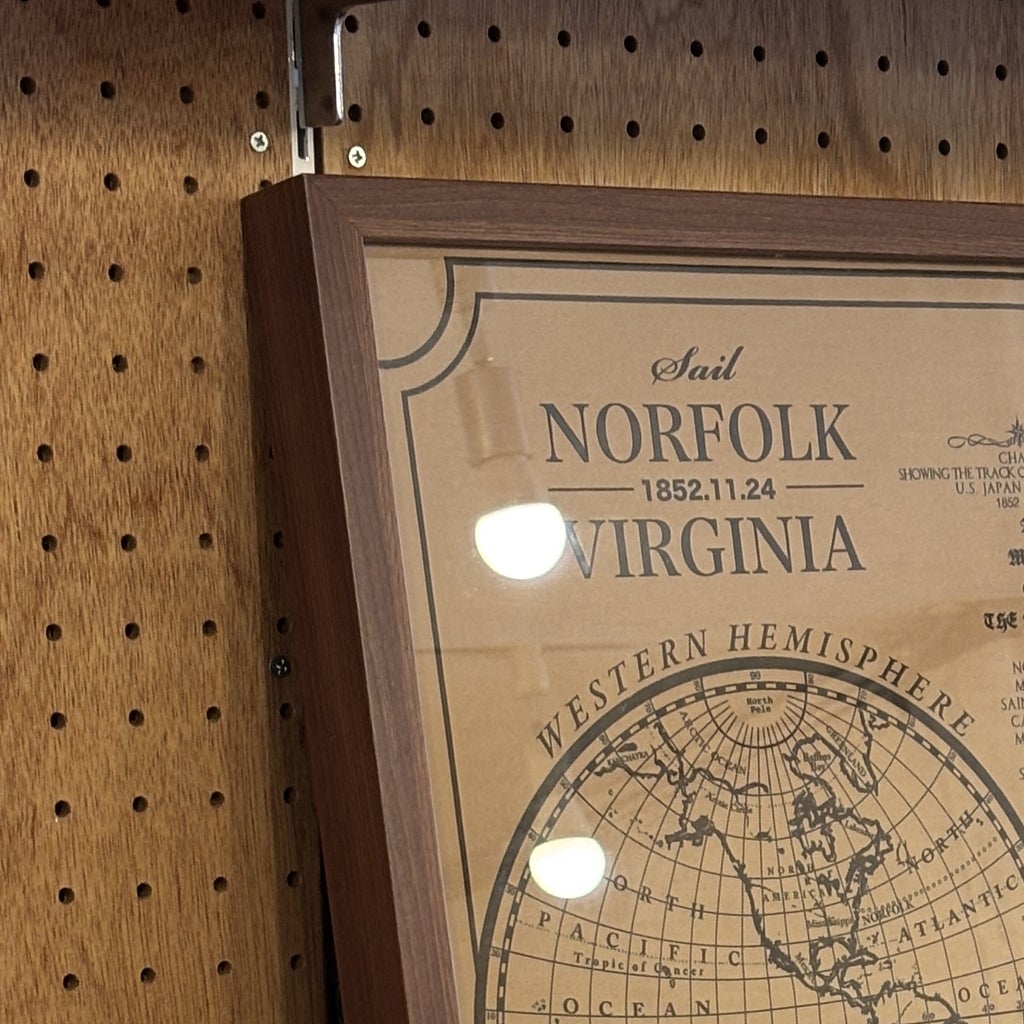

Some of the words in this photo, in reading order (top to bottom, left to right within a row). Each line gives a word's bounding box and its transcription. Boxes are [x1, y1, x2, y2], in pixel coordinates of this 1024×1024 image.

[651, 346, 744, 385] Sail
[540, 402, 857, 463] NORFOLK
[899, 467, 950, 481] SHOWING
[952, 467, 974, 480] THE
[976, 466, 1016, 480] TRACK
[641, 478, 776, 501] 1852.11.24
[956, 482, 978, 495] U.S.
[983, 482, 1022, 496] JAPAN
[996, 497, 1019, 508] 1852
[563, 514, 867, 579] VIRGINIA
[983, 611, 1018, 633] THE
[536, 629, 708, 760] WESTERN
[728, 622, 975, 738] HEMISPHERE
[563, 998, 712, 1018] OCEAN
